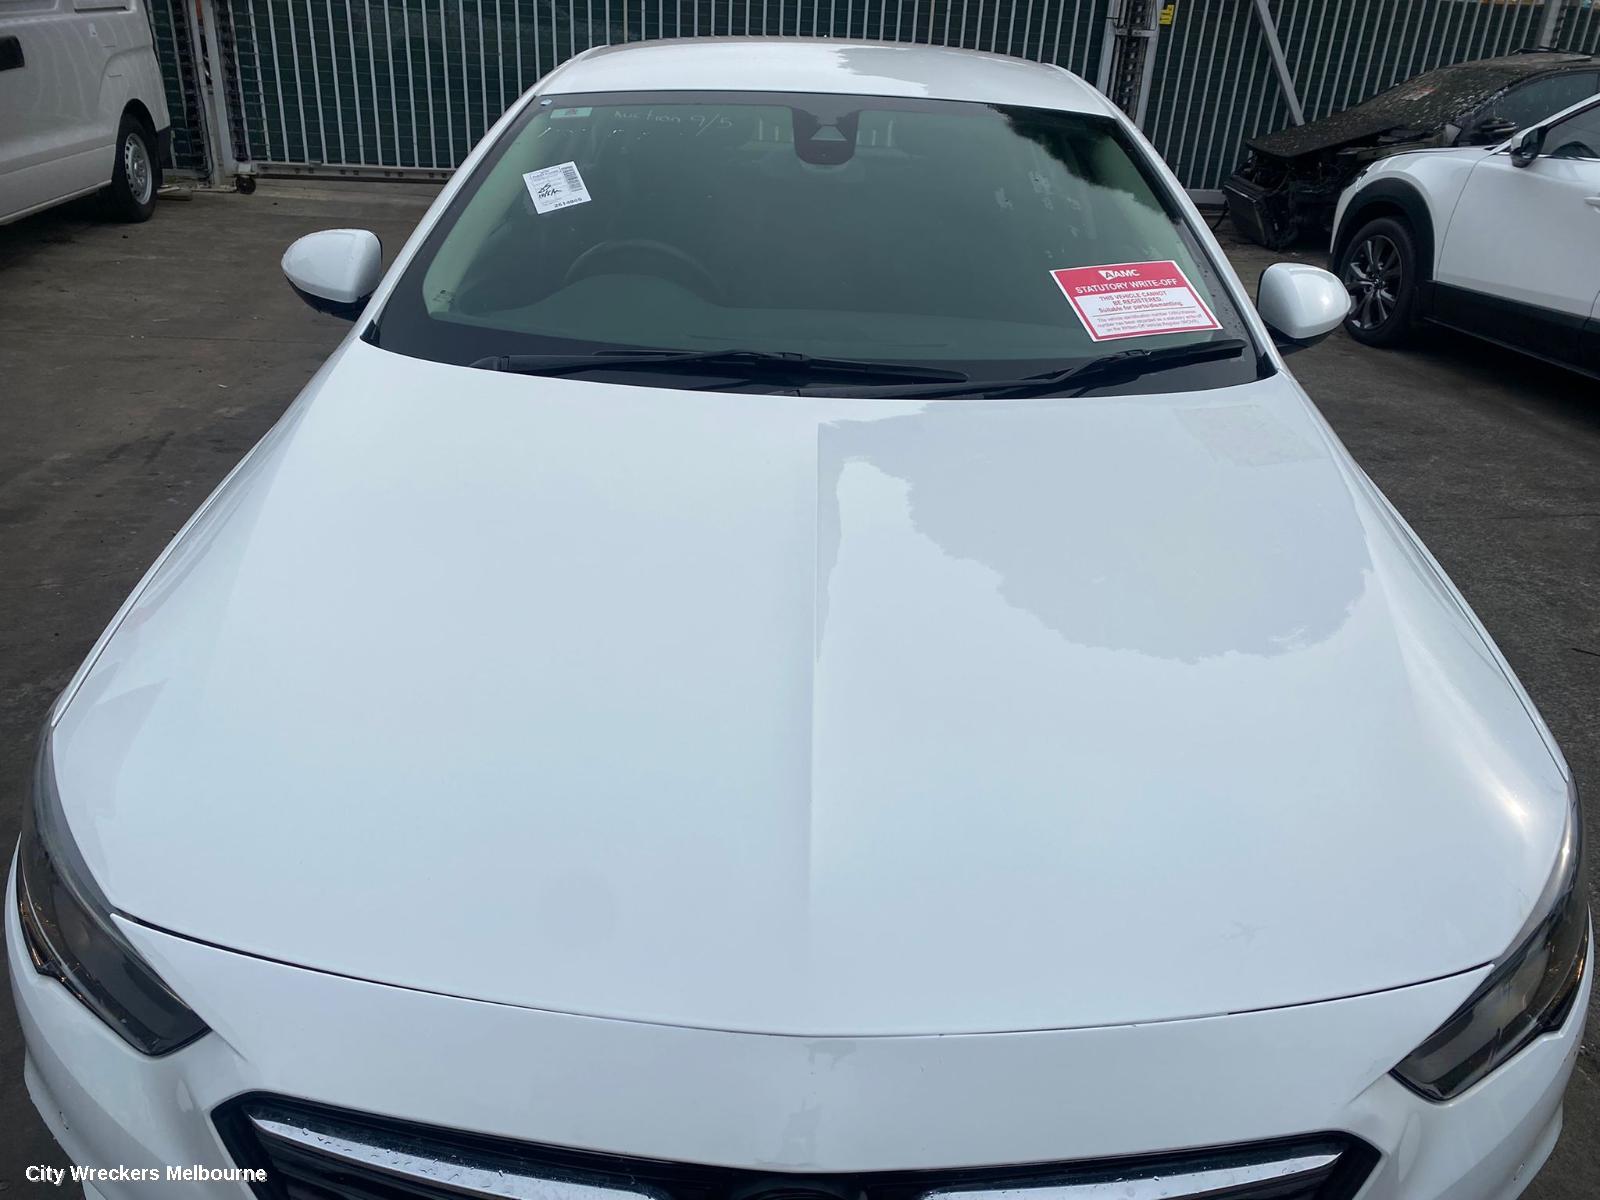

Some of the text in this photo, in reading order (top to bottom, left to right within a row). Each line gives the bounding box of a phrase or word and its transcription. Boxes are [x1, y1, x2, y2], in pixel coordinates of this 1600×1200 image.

[1075, 278, 1177, 294] STATUTORY WRITE-OFF
[1114, 292, 1141, 300] VEHICLE
